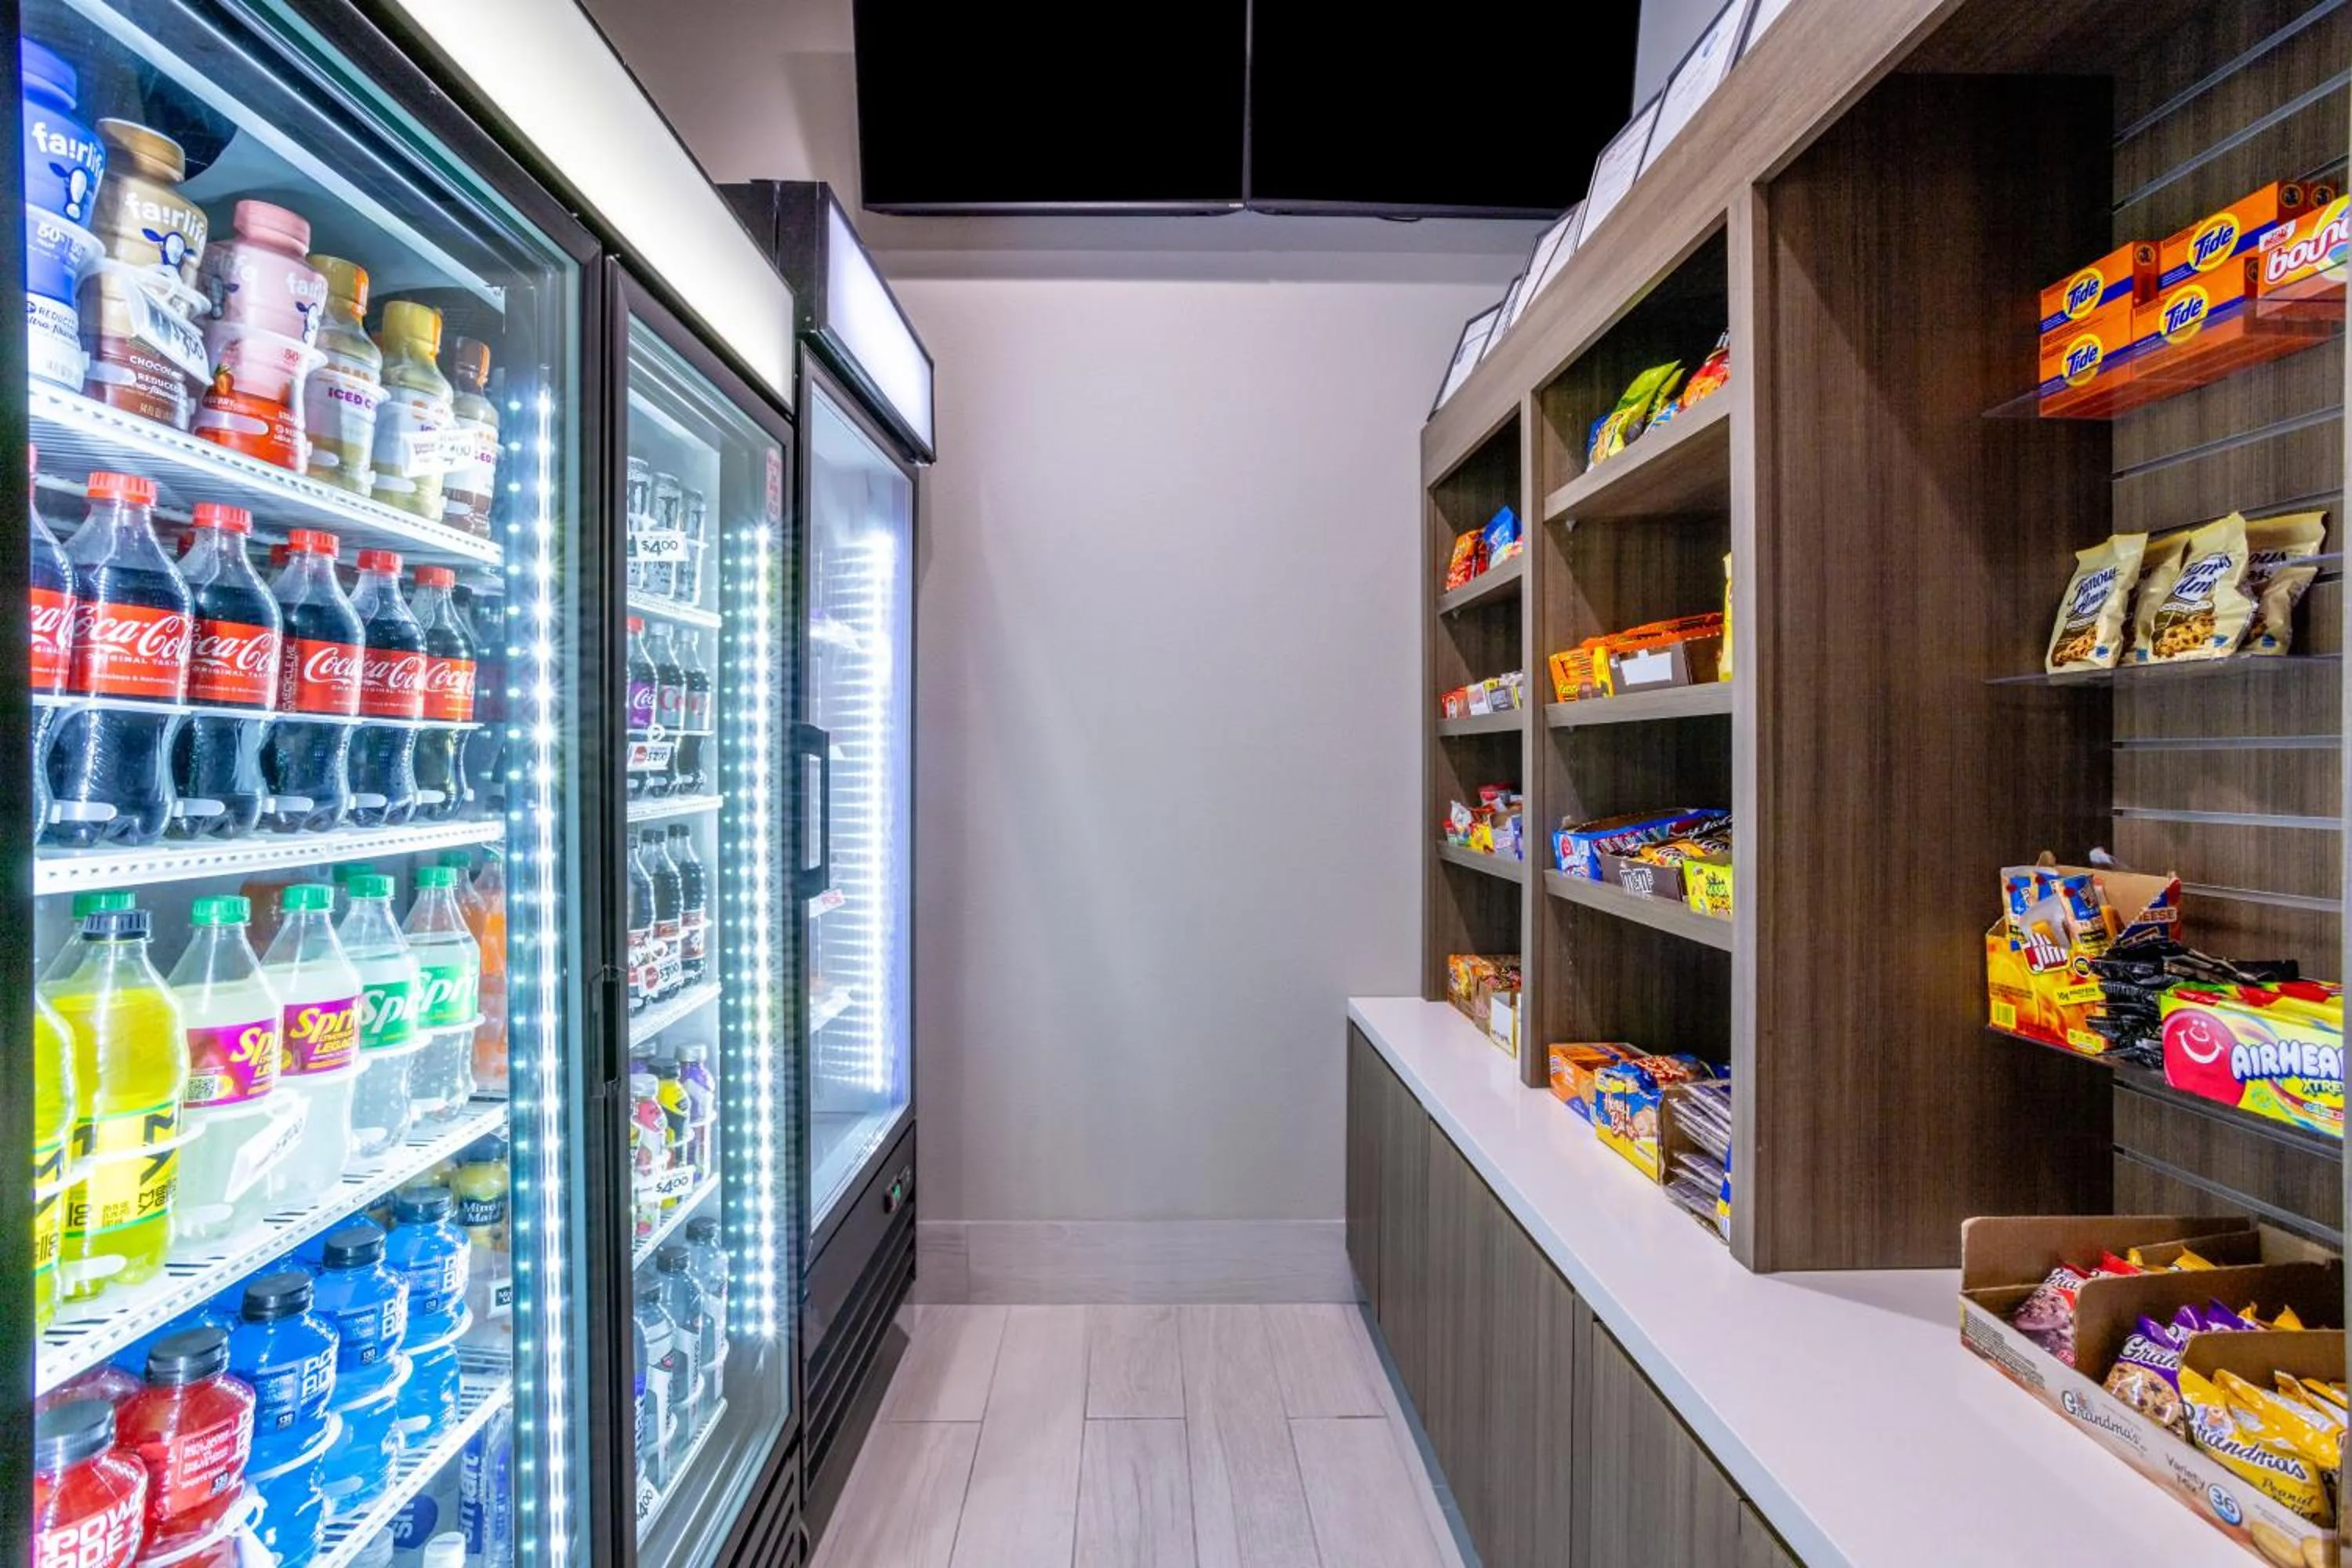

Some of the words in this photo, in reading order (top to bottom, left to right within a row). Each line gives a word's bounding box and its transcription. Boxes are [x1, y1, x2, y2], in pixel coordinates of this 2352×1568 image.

[31, 122, 104, 177] fairlif
[125, 192, 205, 248] fairlif
[2194, 225, 2234, 265] Tide
[2267, 220, 2349, 281] boun
[2067, 278, 2099, 314] Tide
[2165, 297, 2205, 334] Tide
[2067, 345, 2099, 376] Tide
[328, 387, 363, 405] ICED
[2140, 907, 2176, 922] EESE
[2230, 1040, 2344, 1080] AIRHEA
[2303, 1080, 2345, 1095] XTRE
[2060, 1390, 2141, 1445] Grandma's
[2165, 1453, 2206, 1490] Variety
[2212, 1487, 2236, 1510] 36
[2263, 1477, 2316, 1507] Peanut
